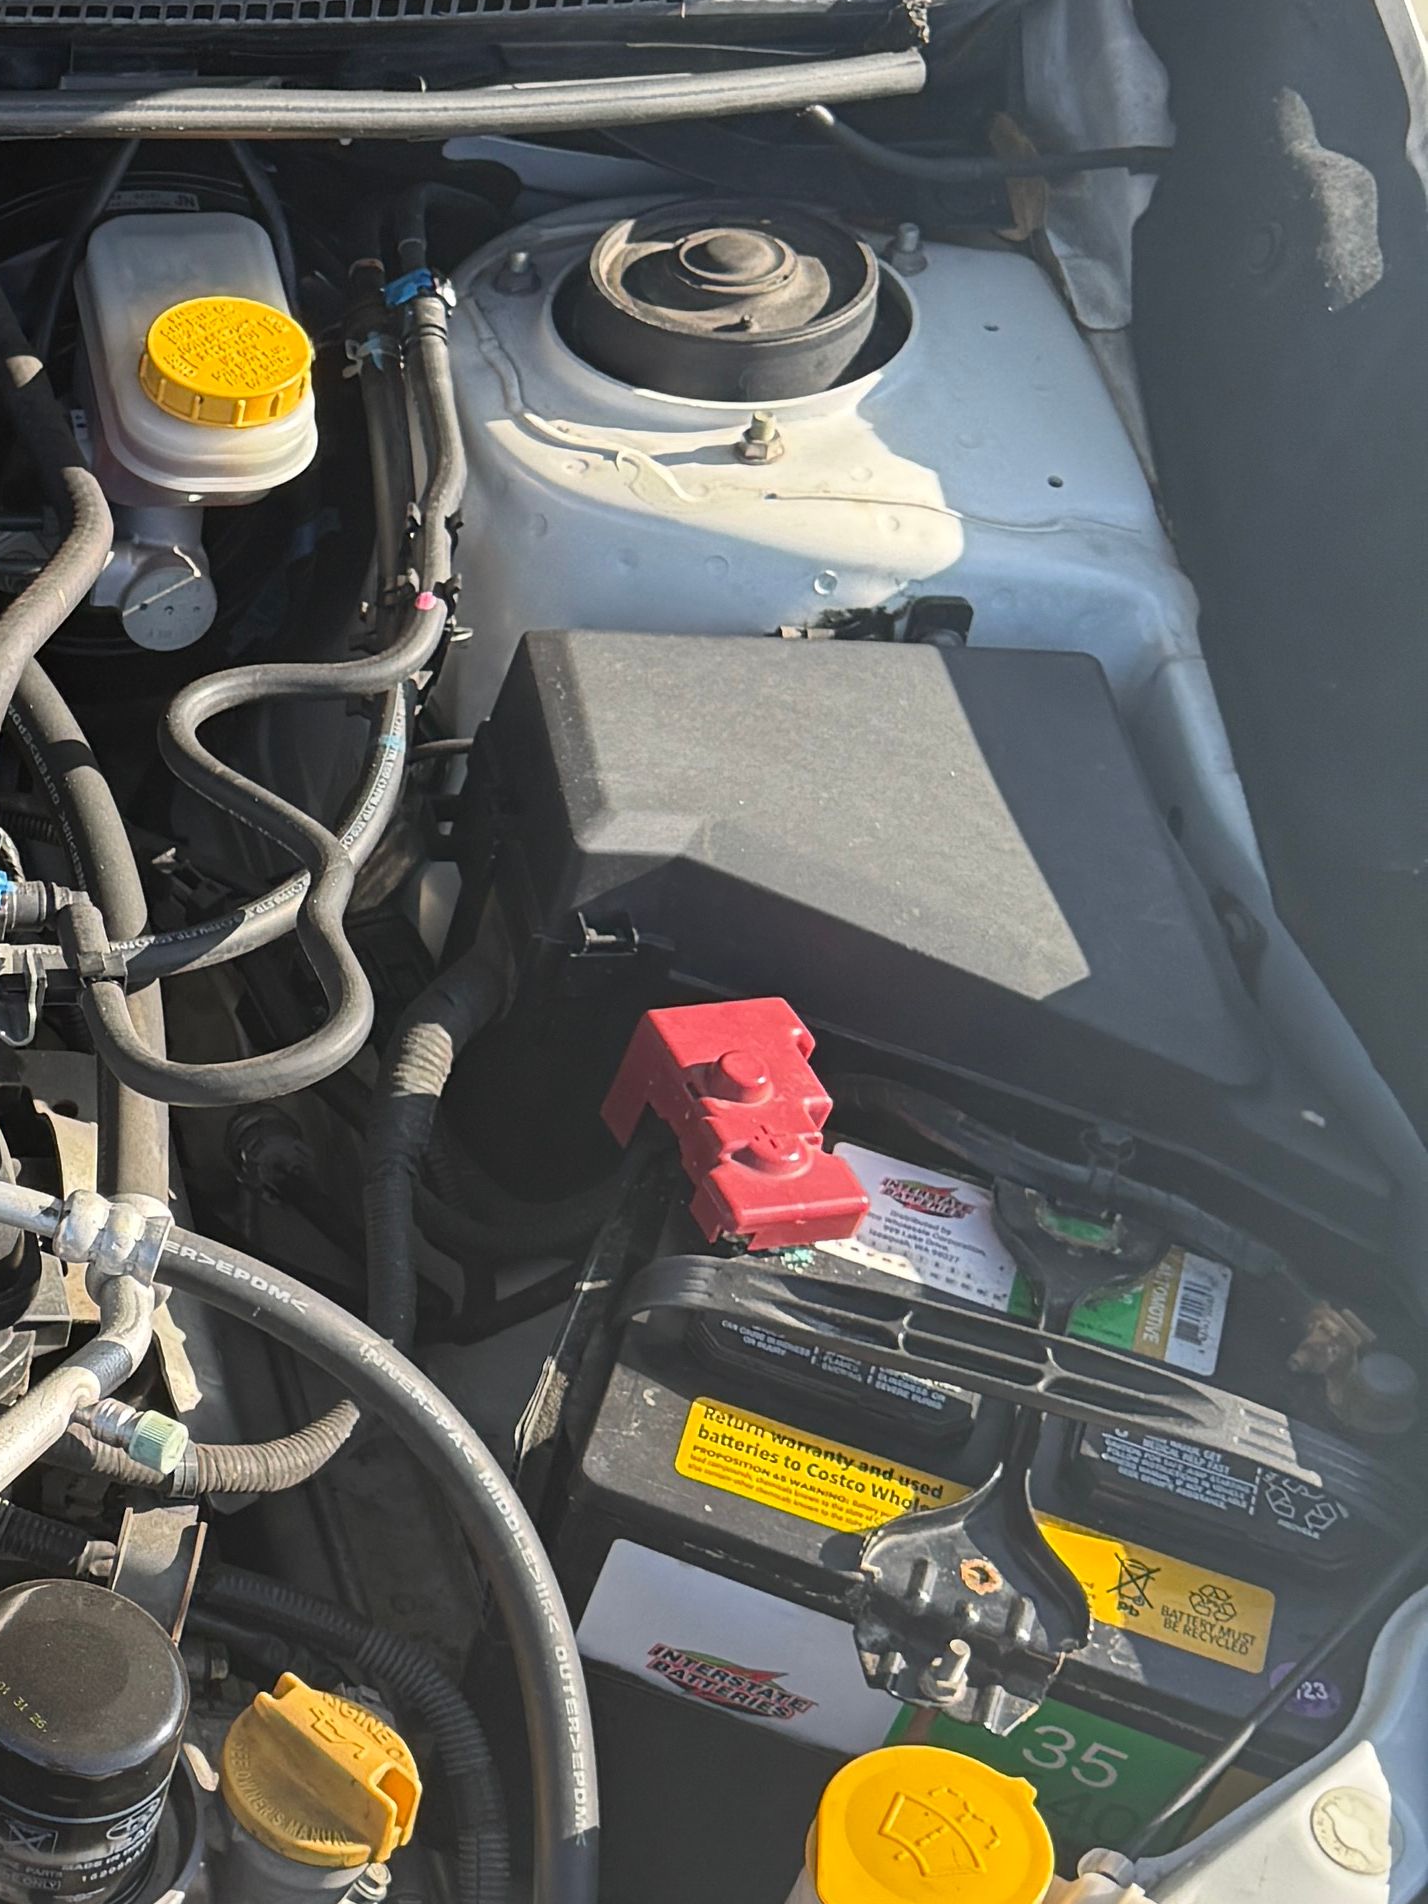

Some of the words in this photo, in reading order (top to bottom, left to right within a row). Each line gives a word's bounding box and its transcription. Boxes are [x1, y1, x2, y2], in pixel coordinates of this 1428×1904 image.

[1143, 1261, 1173, 1345] AUTOMOTIVE
[693, 1444, 771, 1478] PROPOSITION
[789, 1477, 850, 1505] WARNING:
[698, 1424, 779, 1465] batteries
[782, 1454, 801, 1473] to
[806, 1463, 866, 1494] Costco
[704, 1406, 767, 1439] Return
[770, 1431, 855, 1471] warranty
[858, 1460, 895, 1481] and
[899, 1472, 944, 1499] used
[1117, 1600, 1141, 1619] Pb
[1160, 1604, 1218, 1636] BATTERY
[1217, 1623, 1257, 1647] MUST
[1163, 1618, 1180, 1633] BE
[1182, 1624, 1250, 1656] RECYCLED
[646, 1658, 796, 1720] BATTERIES
[648, 1643, 814, 1714] INTERSTATE
[1021, 1724, 1129, 1789] 35
